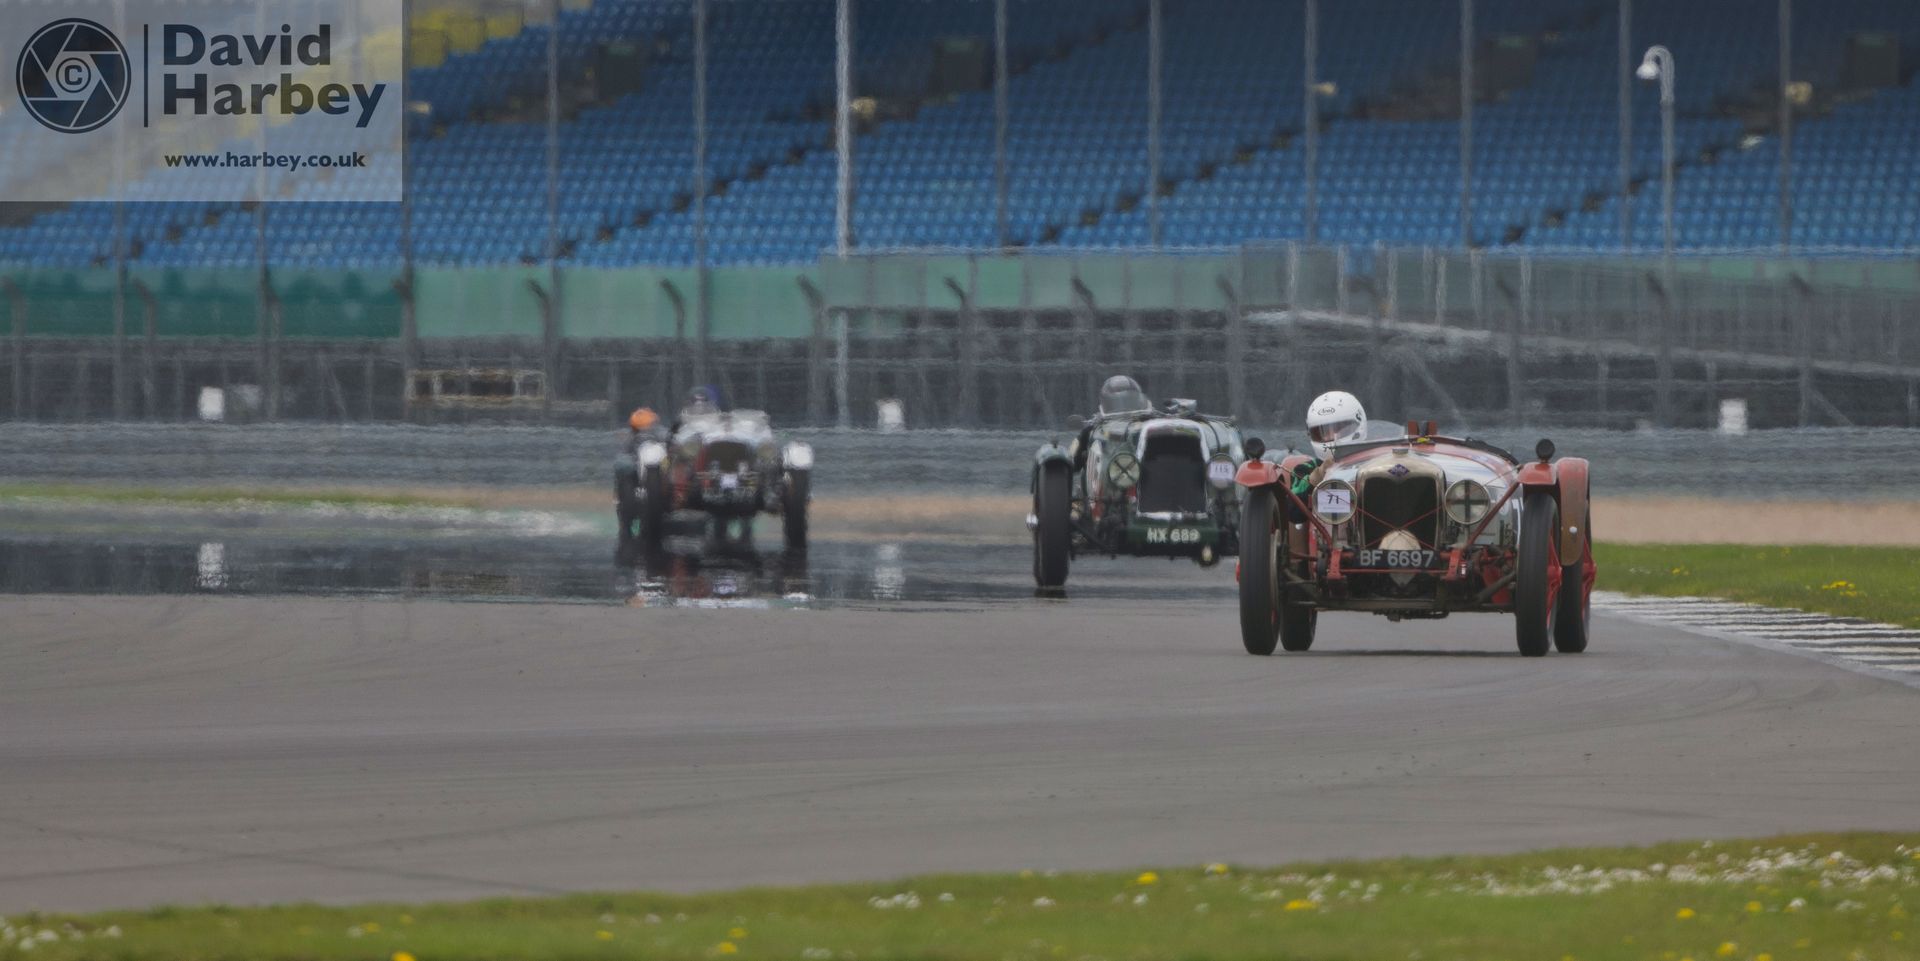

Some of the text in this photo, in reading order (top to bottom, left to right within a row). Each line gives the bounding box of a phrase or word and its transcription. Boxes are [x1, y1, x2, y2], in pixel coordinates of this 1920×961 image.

[1327, 494, 1339, 505] 71
[1170, 528, 1201, 544] 689
[1360, 550, 1434, 568] BF 6697
